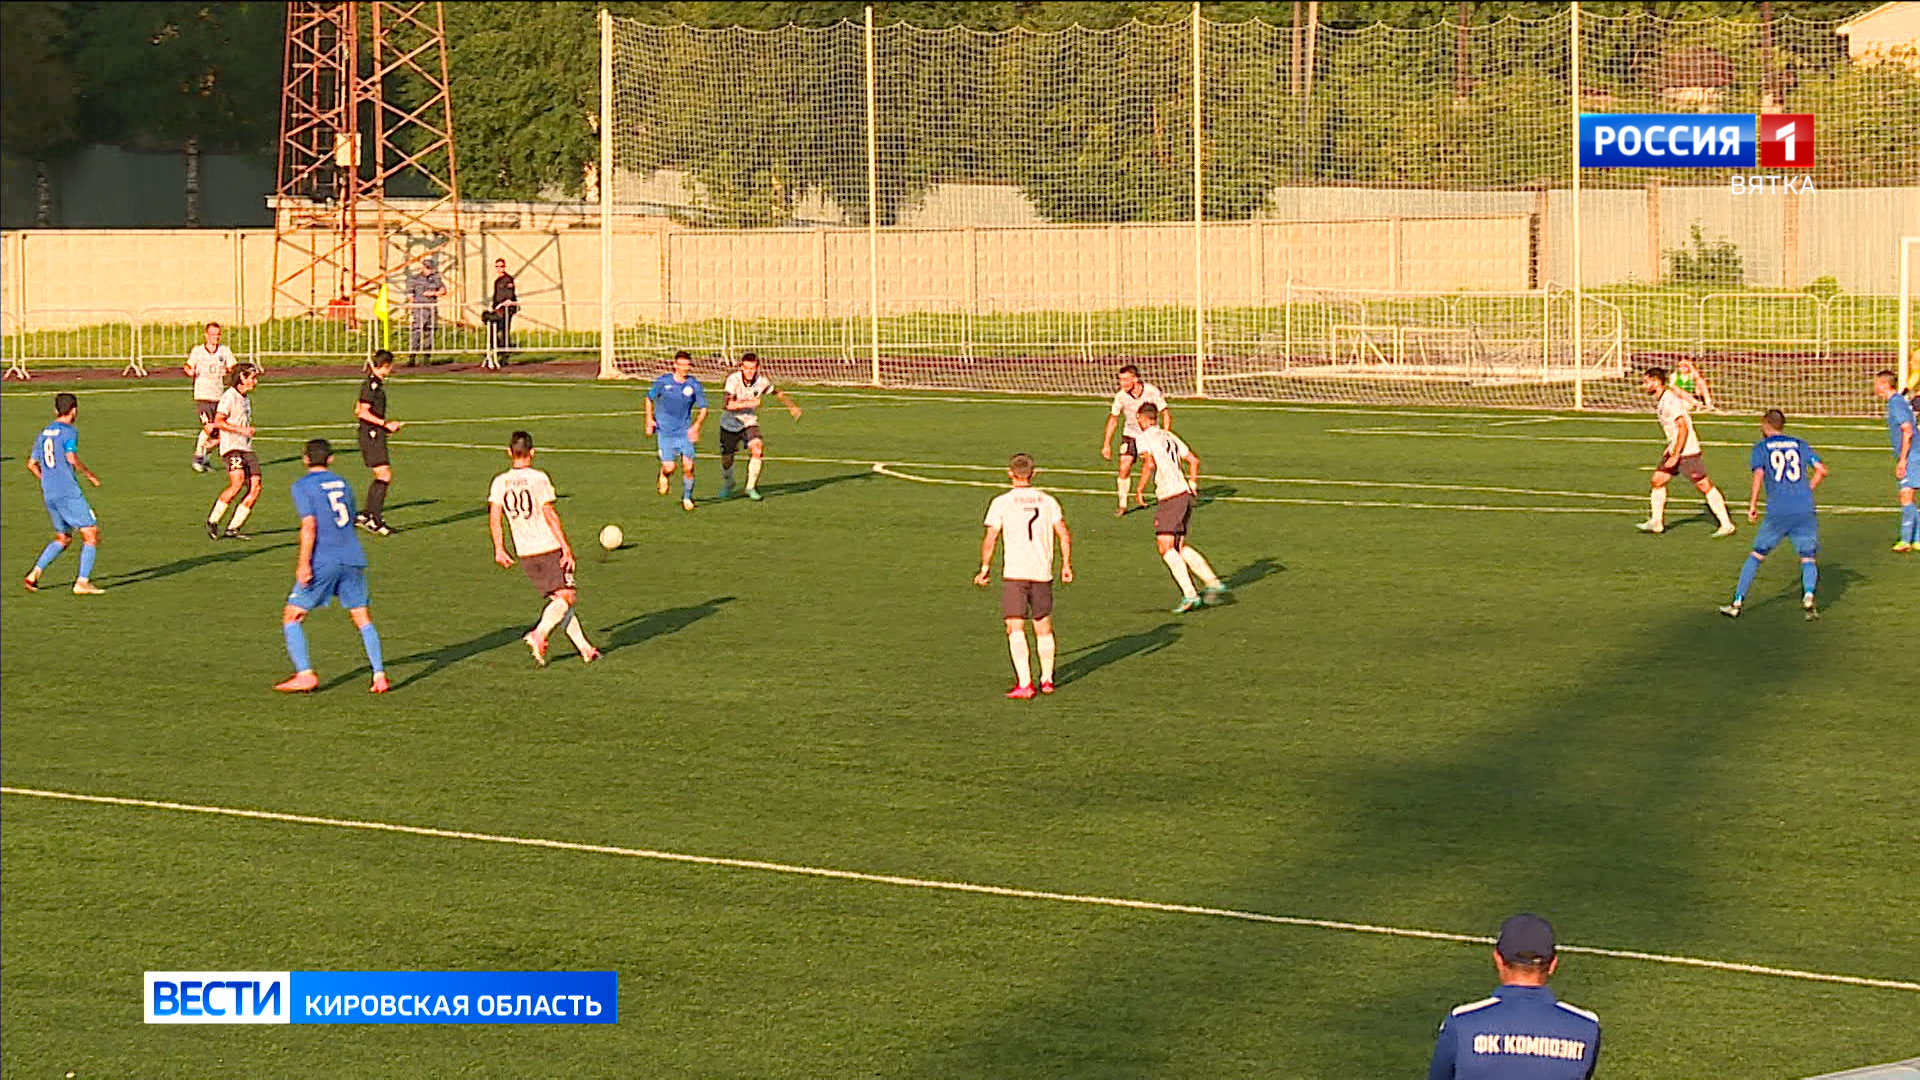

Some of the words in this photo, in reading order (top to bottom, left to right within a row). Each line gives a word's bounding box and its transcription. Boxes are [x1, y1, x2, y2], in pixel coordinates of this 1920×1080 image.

[43, 437, 55, 468] 8
[1770, 449, 1801, 482] 93
[327, 491, 349, 527] 5
[503, 489, 533, 519] 99
[1023, 506, 1040, 541] 7
[1474, 1034, 1500, 1054] ФК
[1504, 1034, 1586, 1060] КОМПОЗИТ
